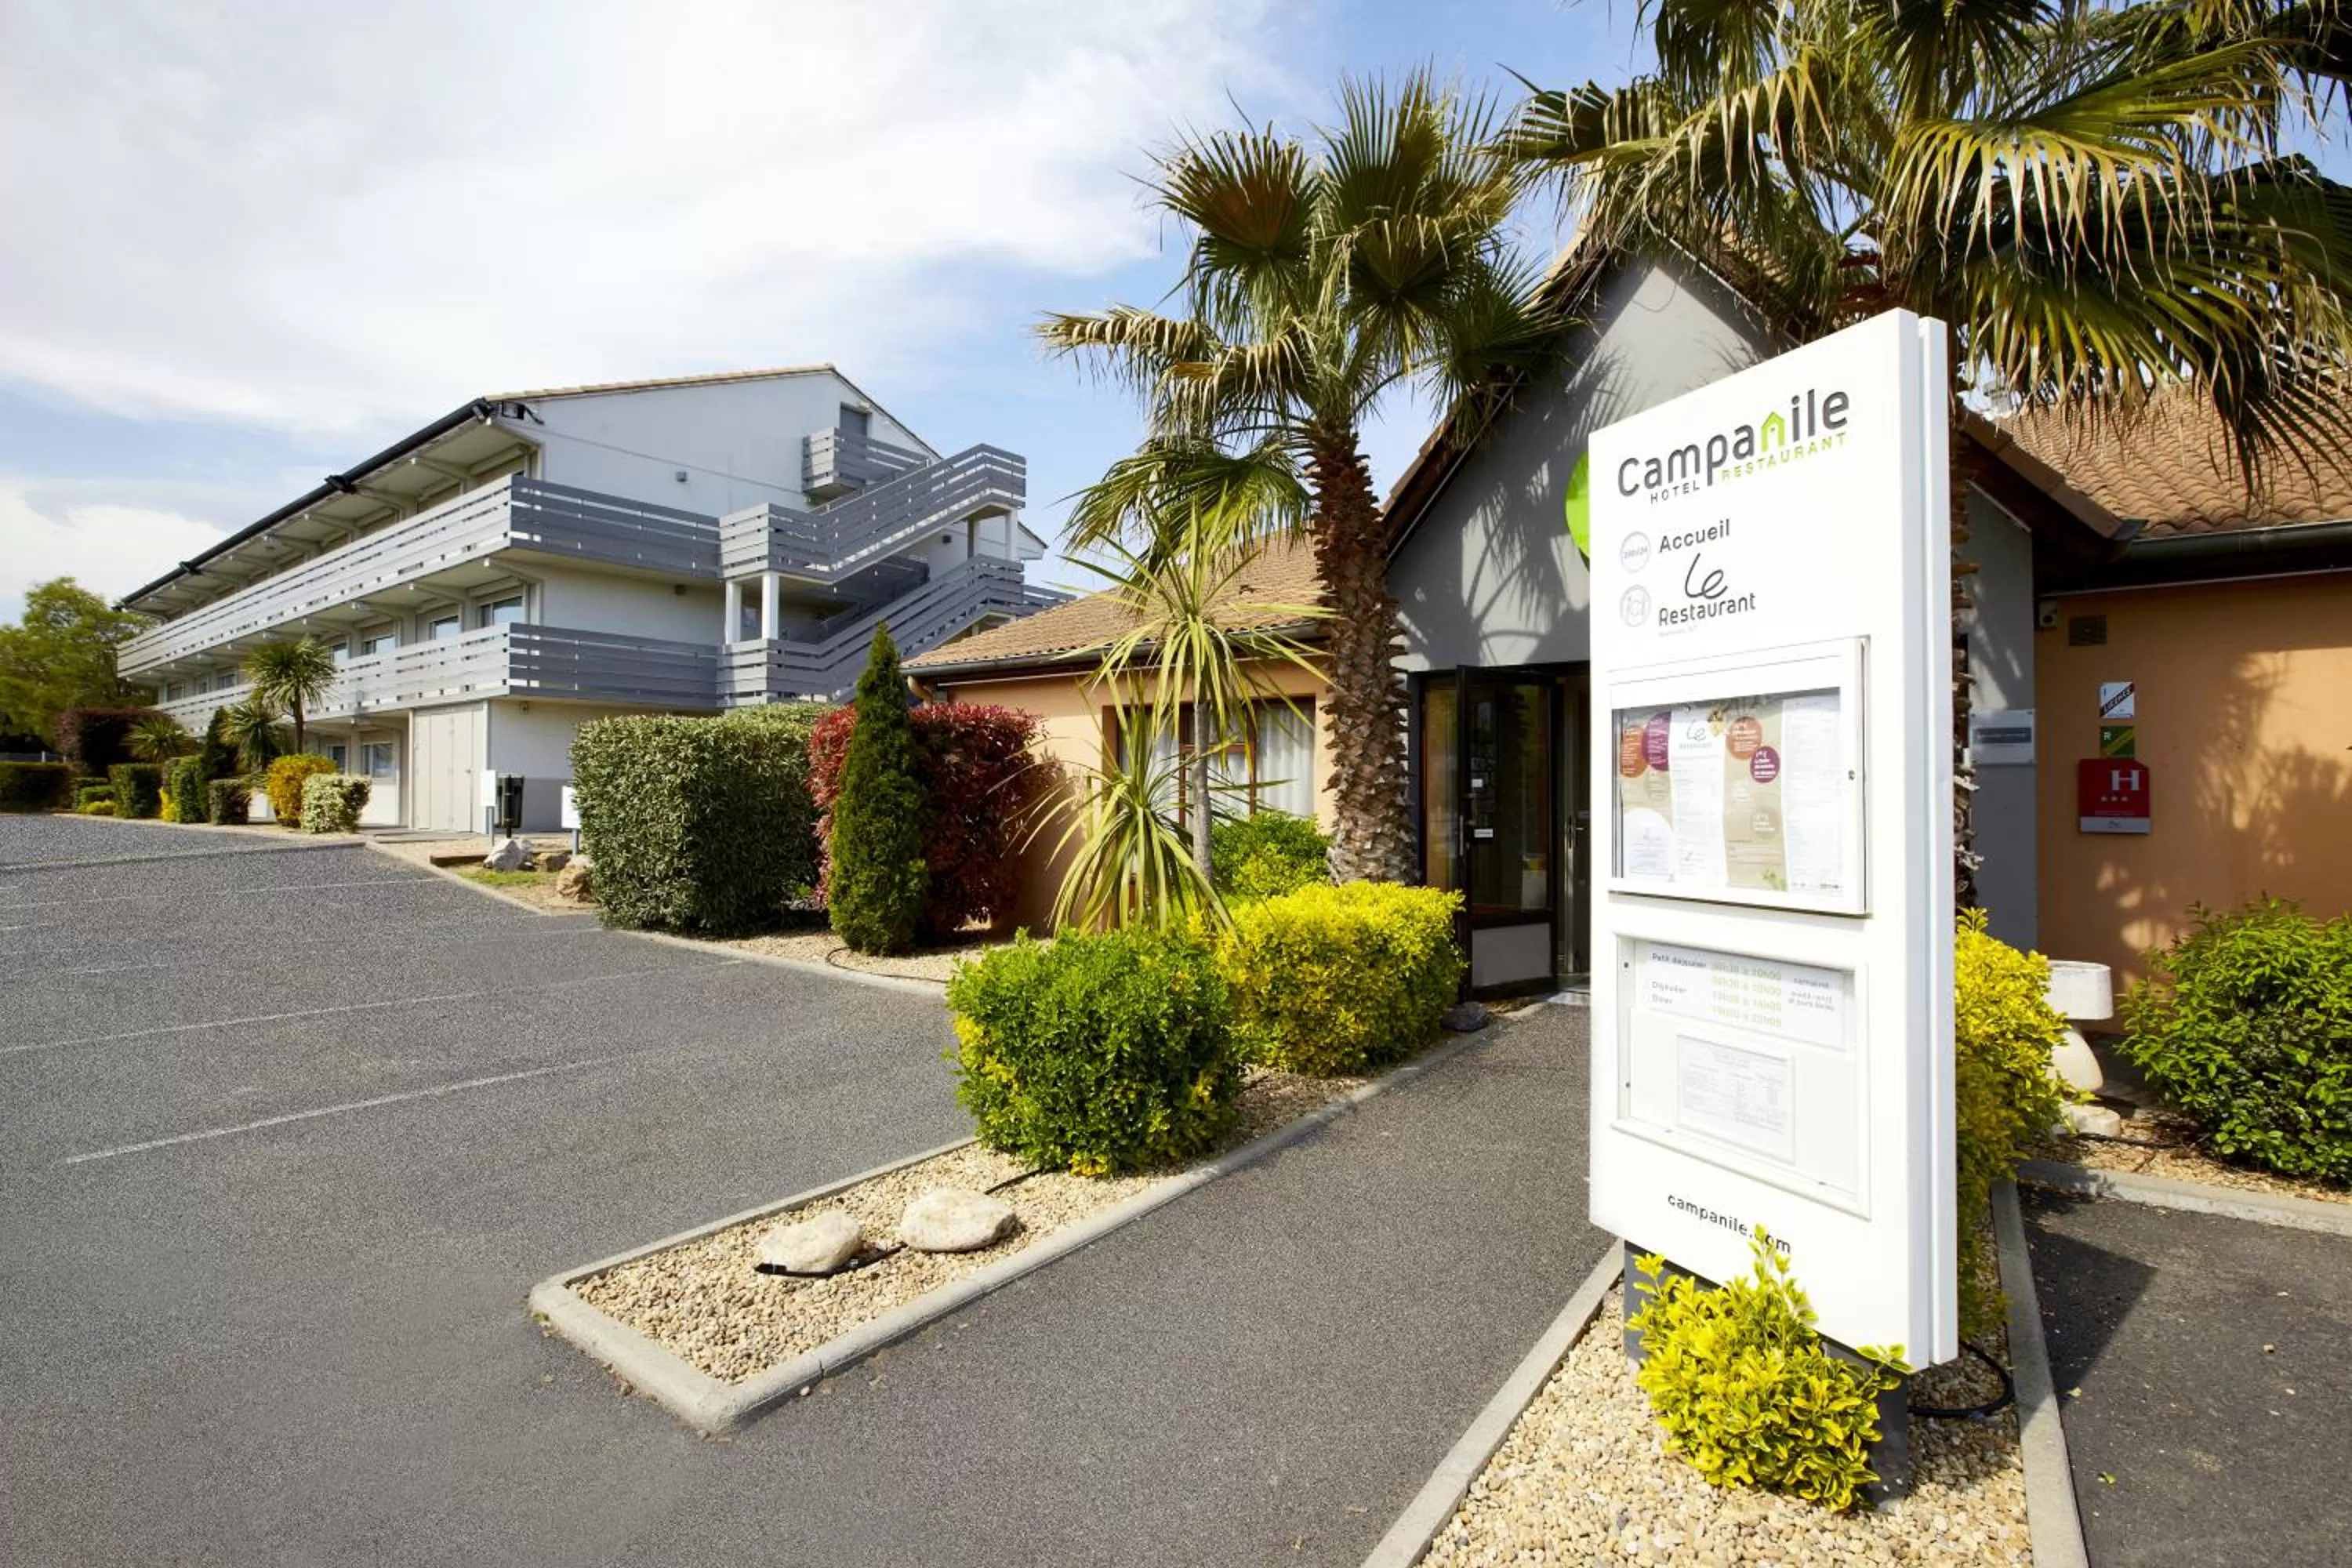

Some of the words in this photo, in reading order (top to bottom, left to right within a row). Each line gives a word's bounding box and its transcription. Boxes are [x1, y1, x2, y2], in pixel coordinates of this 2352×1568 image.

[1617, 389, 1849, 497] Campanile
[1650, 480, 1700, 505] HOTEL
[1722, 432, 1847, 481] RESTAURANT
[1659, 519, 1730, 554] Accueil
[1685, 553, 1729, 600] Le
[1658, 592, 1756, 626] Restaurant
[2111, 769, 2140, 791] H
[1668, 1194, 1791, 1254] campanile.om
